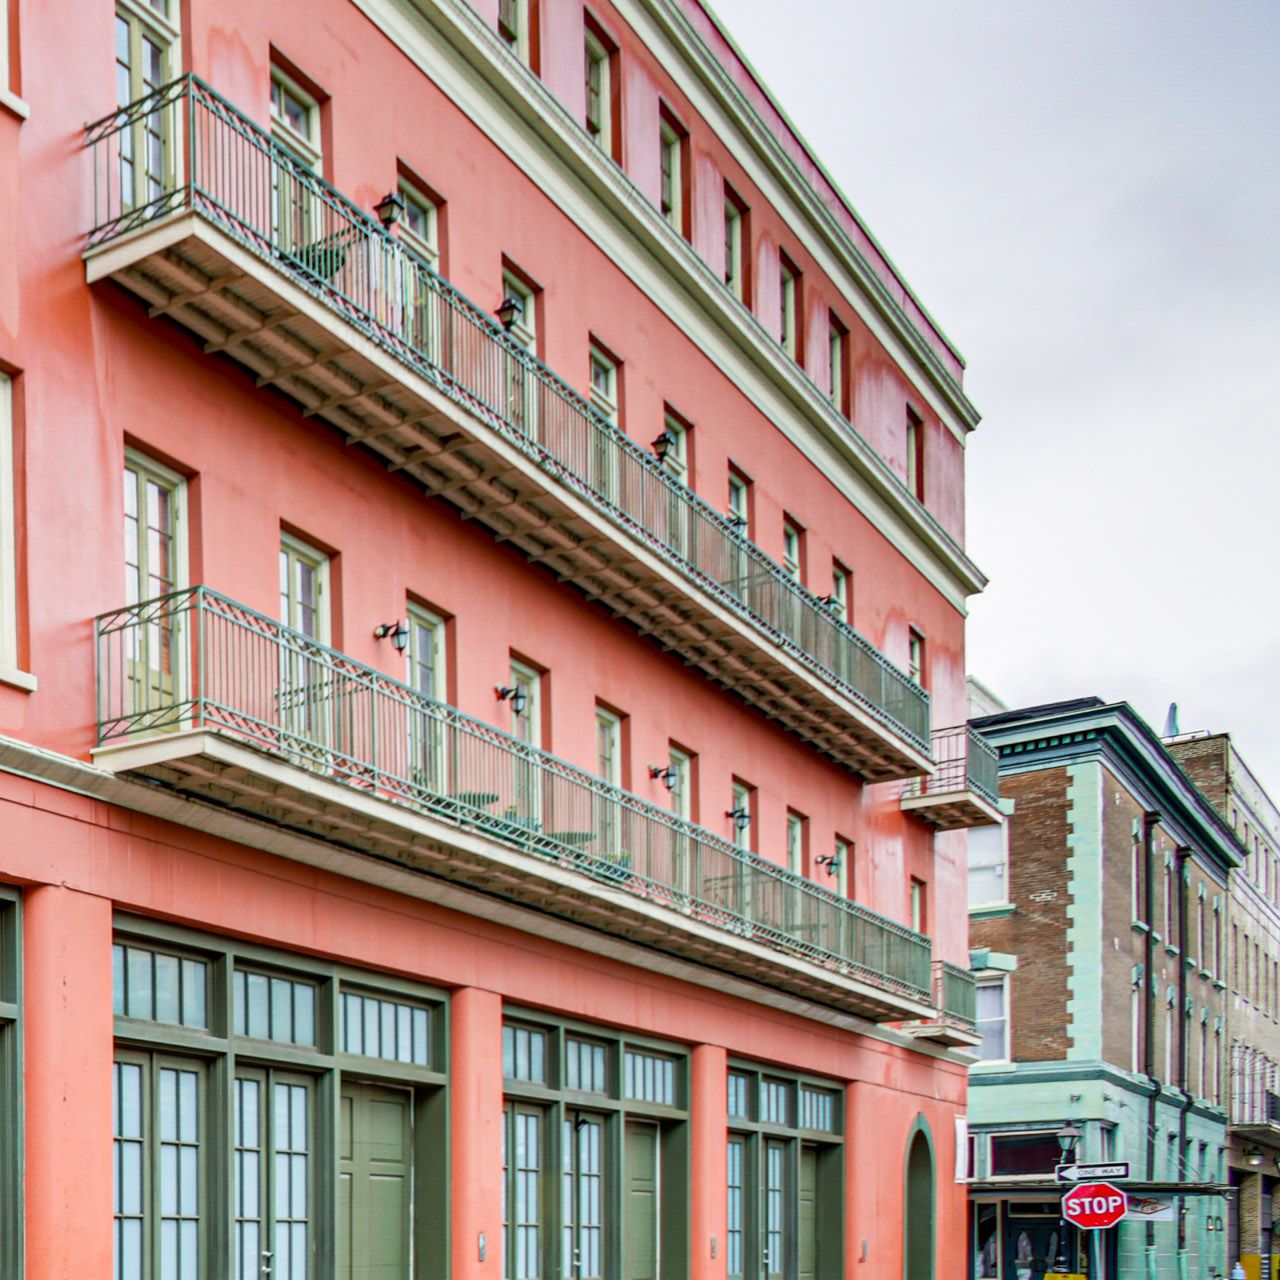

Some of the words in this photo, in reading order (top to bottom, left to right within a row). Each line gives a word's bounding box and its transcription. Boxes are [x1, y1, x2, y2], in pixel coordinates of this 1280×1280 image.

[1078, 1168, 1098, 1177] ONE
[1101, 1167, 1122, 1176] WAY
[1067, 1195, 1122, 1216] STOP
